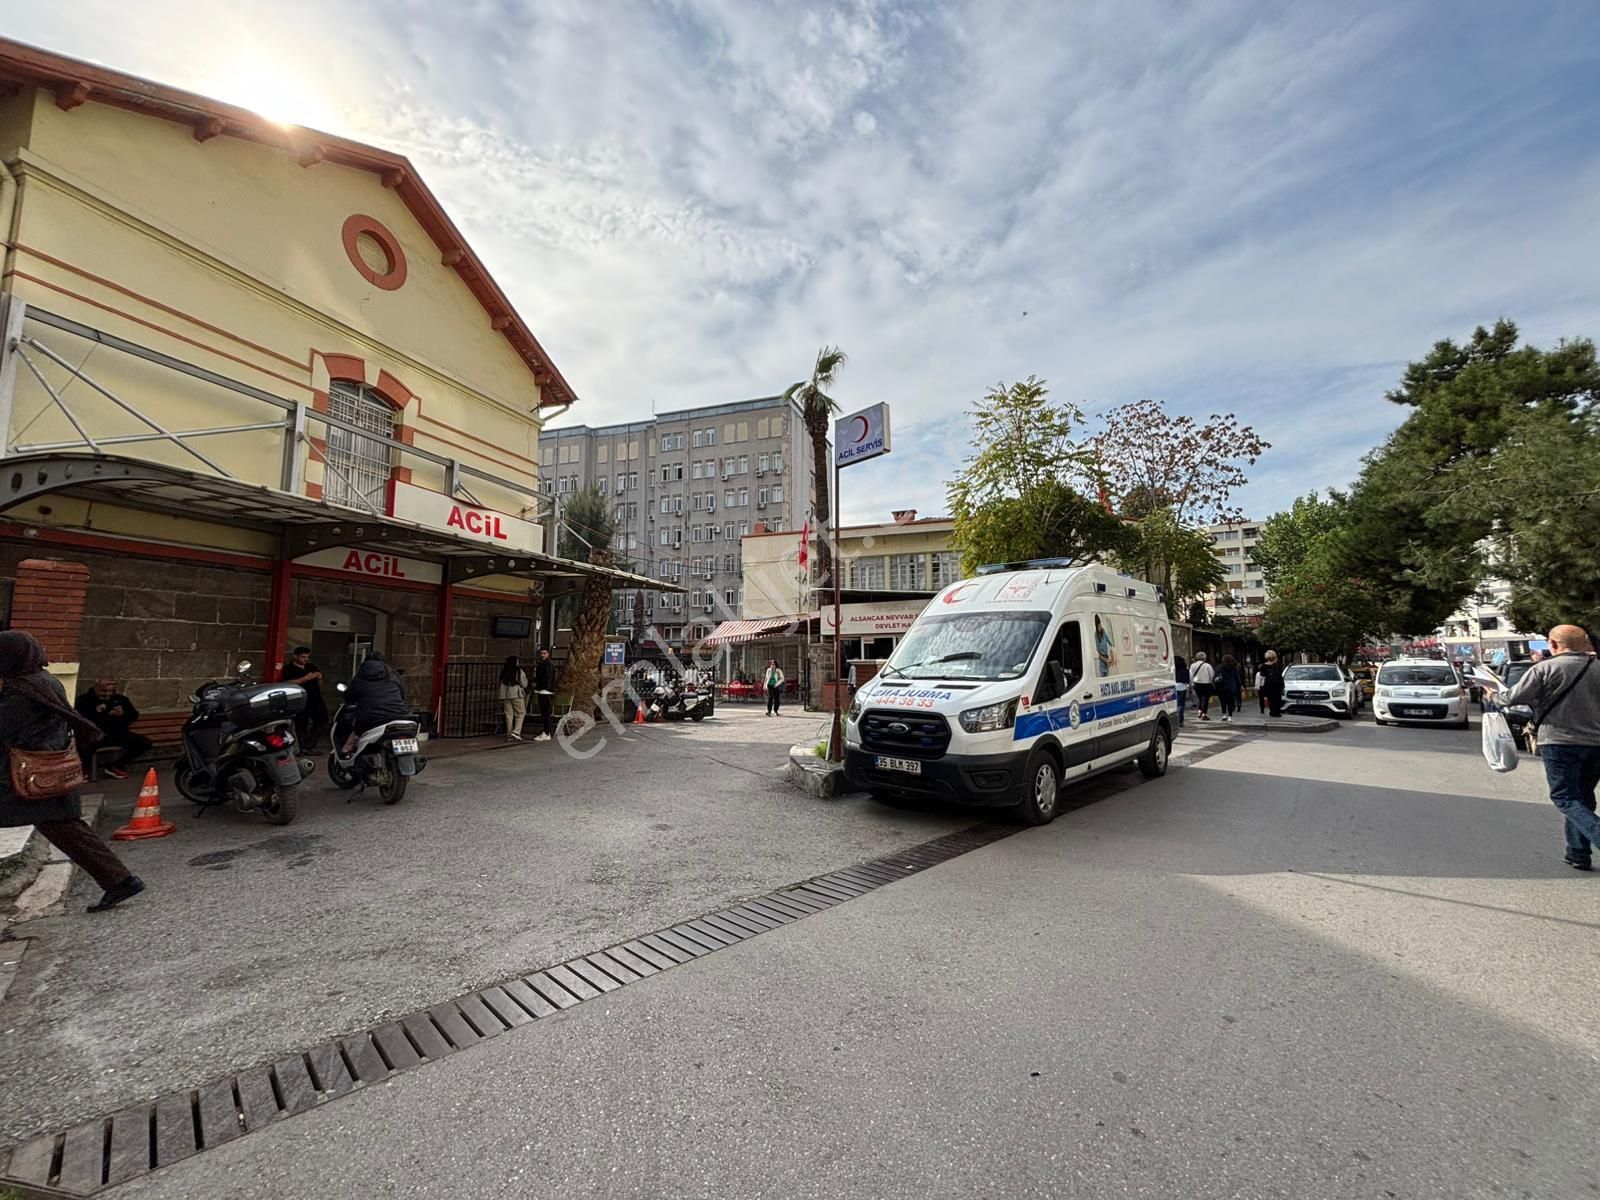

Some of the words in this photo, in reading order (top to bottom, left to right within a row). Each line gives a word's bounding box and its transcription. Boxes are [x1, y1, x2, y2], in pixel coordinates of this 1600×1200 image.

[879, 757, 888, 767] 35
[890, 759, 904, 769] BLM
[905, 761, 919, 771] 397
